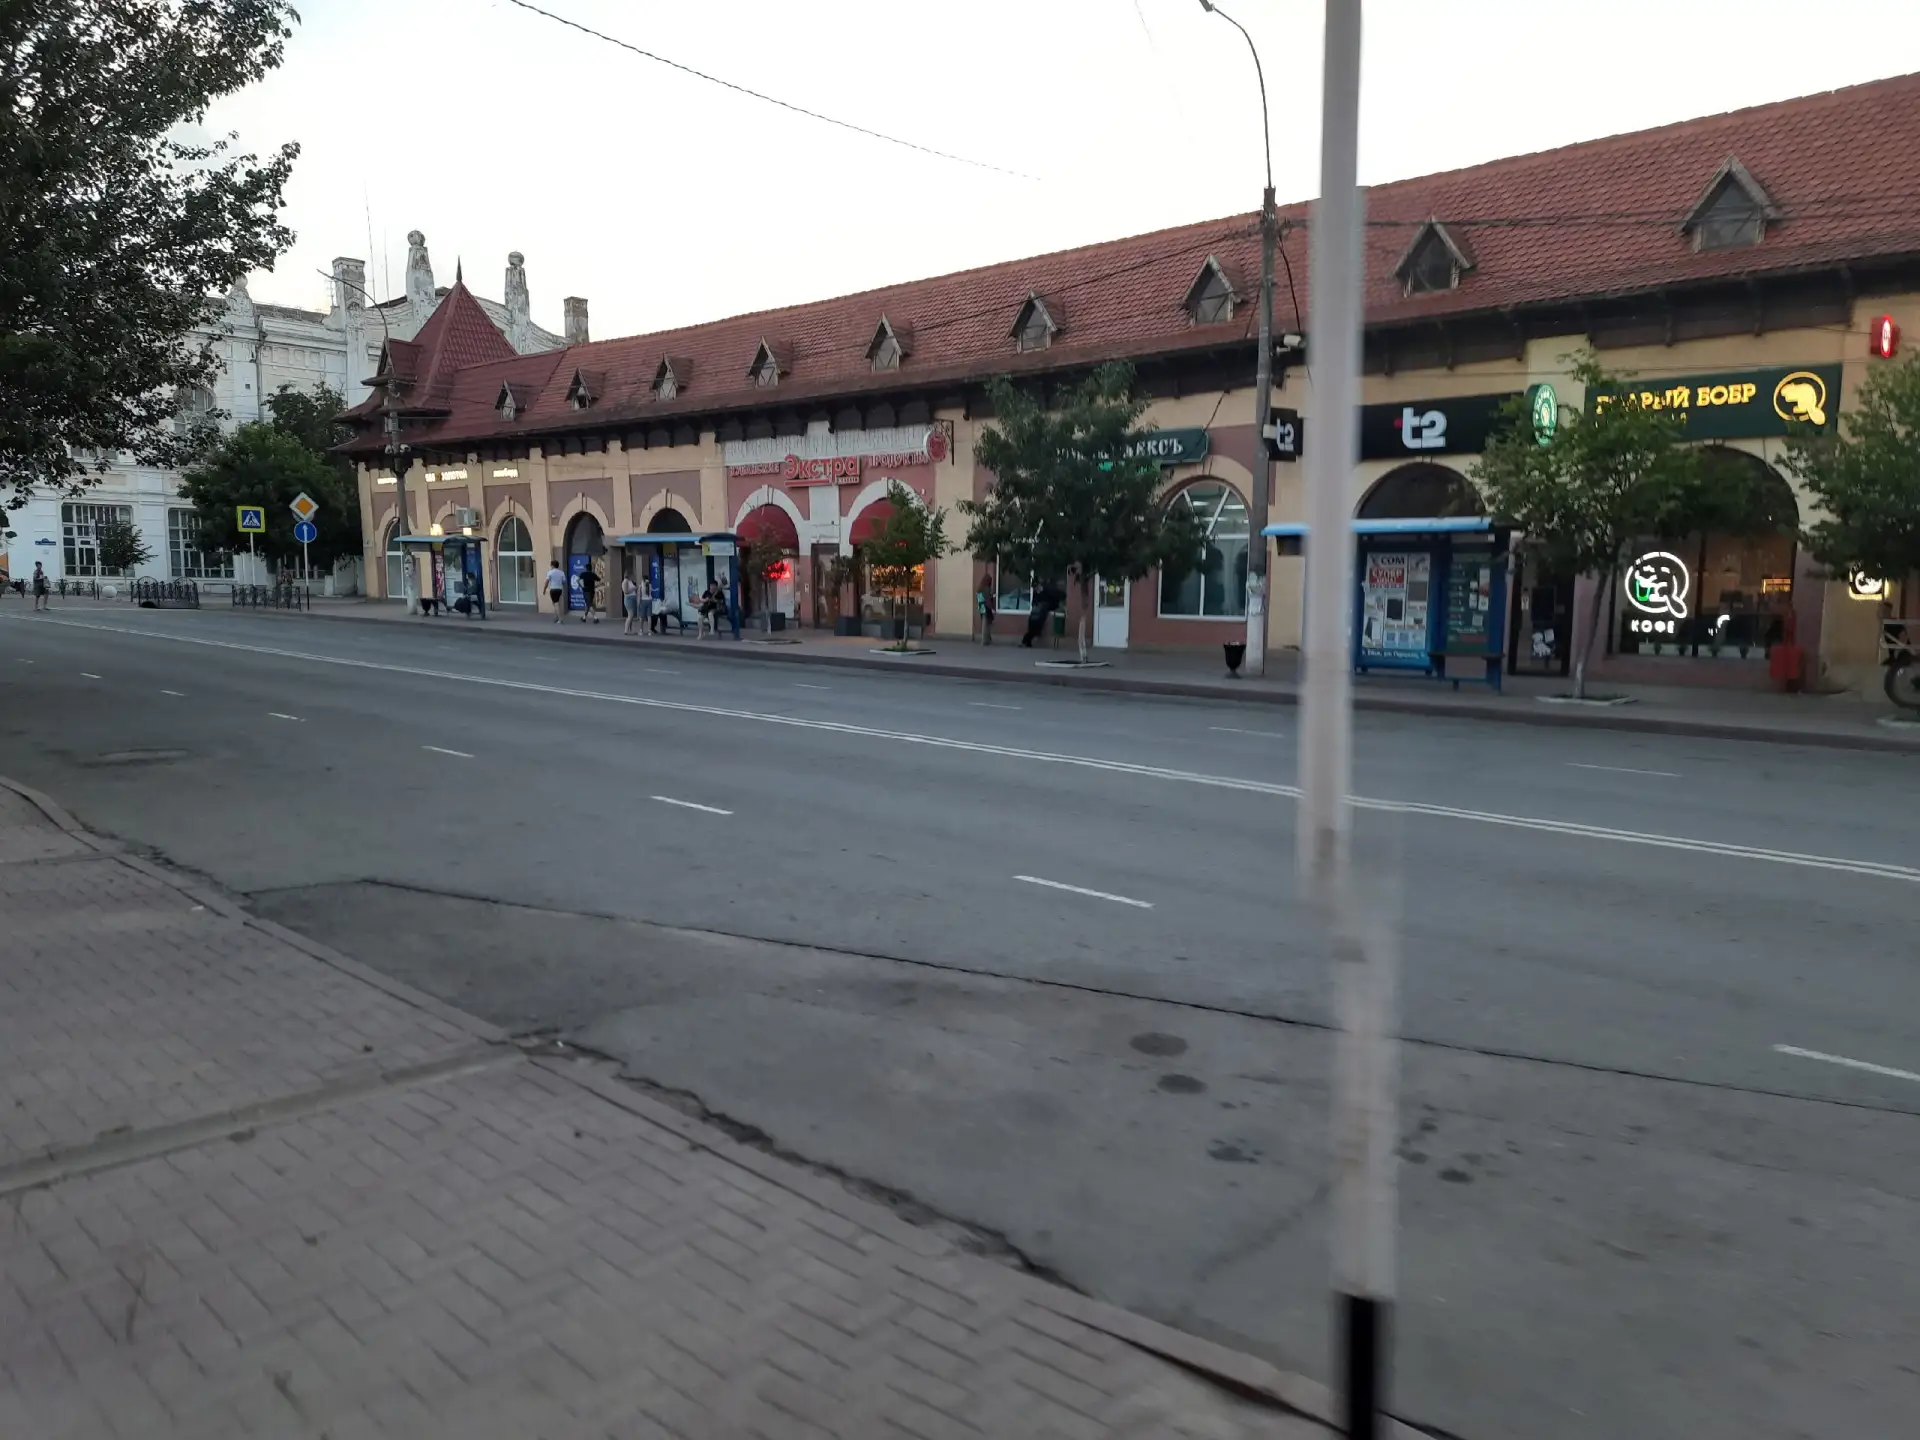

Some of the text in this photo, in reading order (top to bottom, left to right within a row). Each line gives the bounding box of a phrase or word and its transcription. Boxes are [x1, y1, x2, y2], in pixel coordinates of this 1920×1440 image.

[1697, 383, 1756, 406] БОБР
[1276, 418, 1295, 451] t2
[1402, 407, 1447, 449] t2
[784, 454, 859, 484] Экстра
